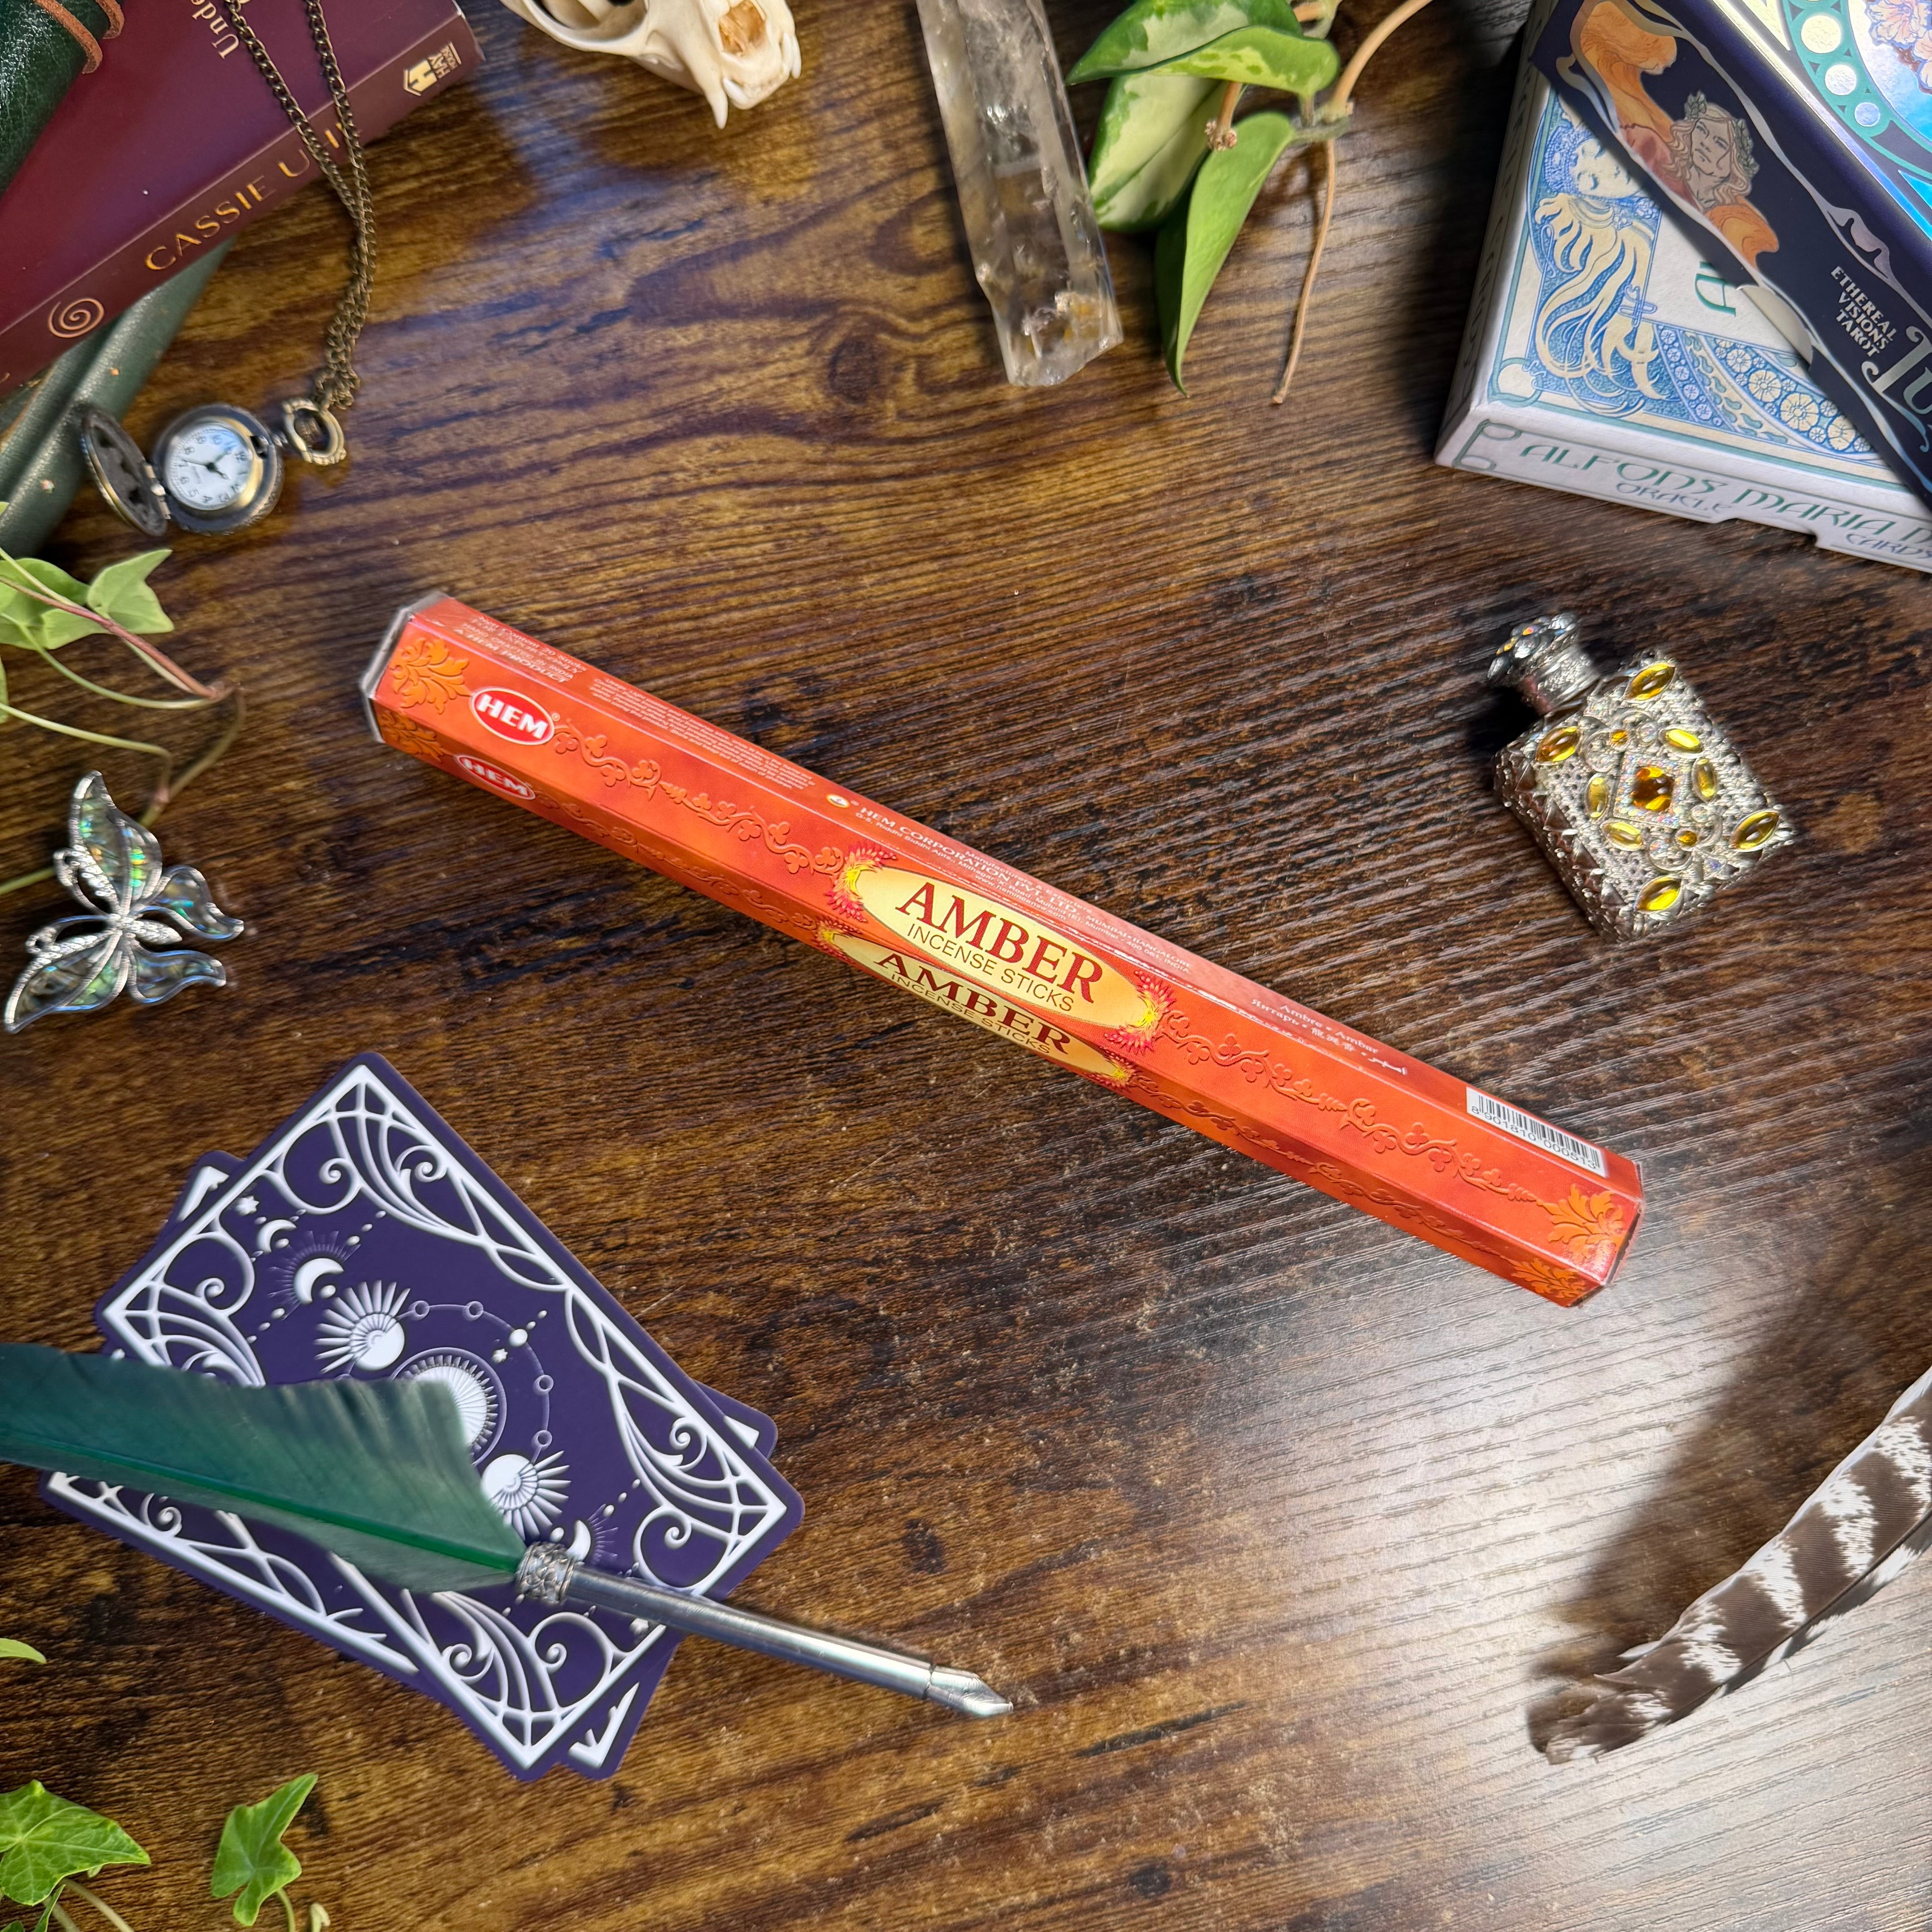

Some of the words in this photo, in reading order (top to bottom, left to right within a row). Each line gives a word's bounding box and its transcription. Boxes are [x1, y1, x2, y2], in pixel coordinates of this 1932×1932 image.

[145, 175, 276, 270] CASSIE
[1831, 266, 1897, 341] ETHEREAL
[1836, 309, 1880, 357] TAROT
[1838, 291, 1889, 350] VISIONS
[1519, 444, 1727, 494] ALFONS
[1733, 489, 1896, 535] MARIA
[1616, 482, 1732, 513] ORACLE
[466, 634, 500, 651] HEM
[498, 650, 569, 684] PRODUCT
[547, 664, 575, 679] INDIA
[478, 694, 548, 739] HEM
[463, 759, 528, 796] HEM
[859, 807, 896, 828] HEM
[899, 825, 1010, 882] CORPORATION
[1014, 880, 1044, 899] PVT.
[1049, 897, 1081, 916] LTD.
[875, 822, 903, 837] Riddhi
[904, 835, 931, 850] Siddhi
[1035, 897, 1066, 915] Mulund
[1085, 921, 1118, 939] Mumbai
[1125, 940, 1142, 951] 400
[895, 882, 1102, 1003] AMBER
[907, 923, 997, 976] INCENSE
[1001, 968, 1074, 1012] STICKS
[875, 953, 1071, 1055] AMBER
[891, 974, 975, 1018] INCENSE
[981, 1018, 1051, 1054] STICKS
[1280, 1005, 1323, 1027] Ambre
[1335, 1031, 1378, 1054] Ambar
[1471, 1104, 1480, 1115] 8
[1484, 1110, 1536, 1142] 901810
[1543, 1139, 1596, 1170] 000513
